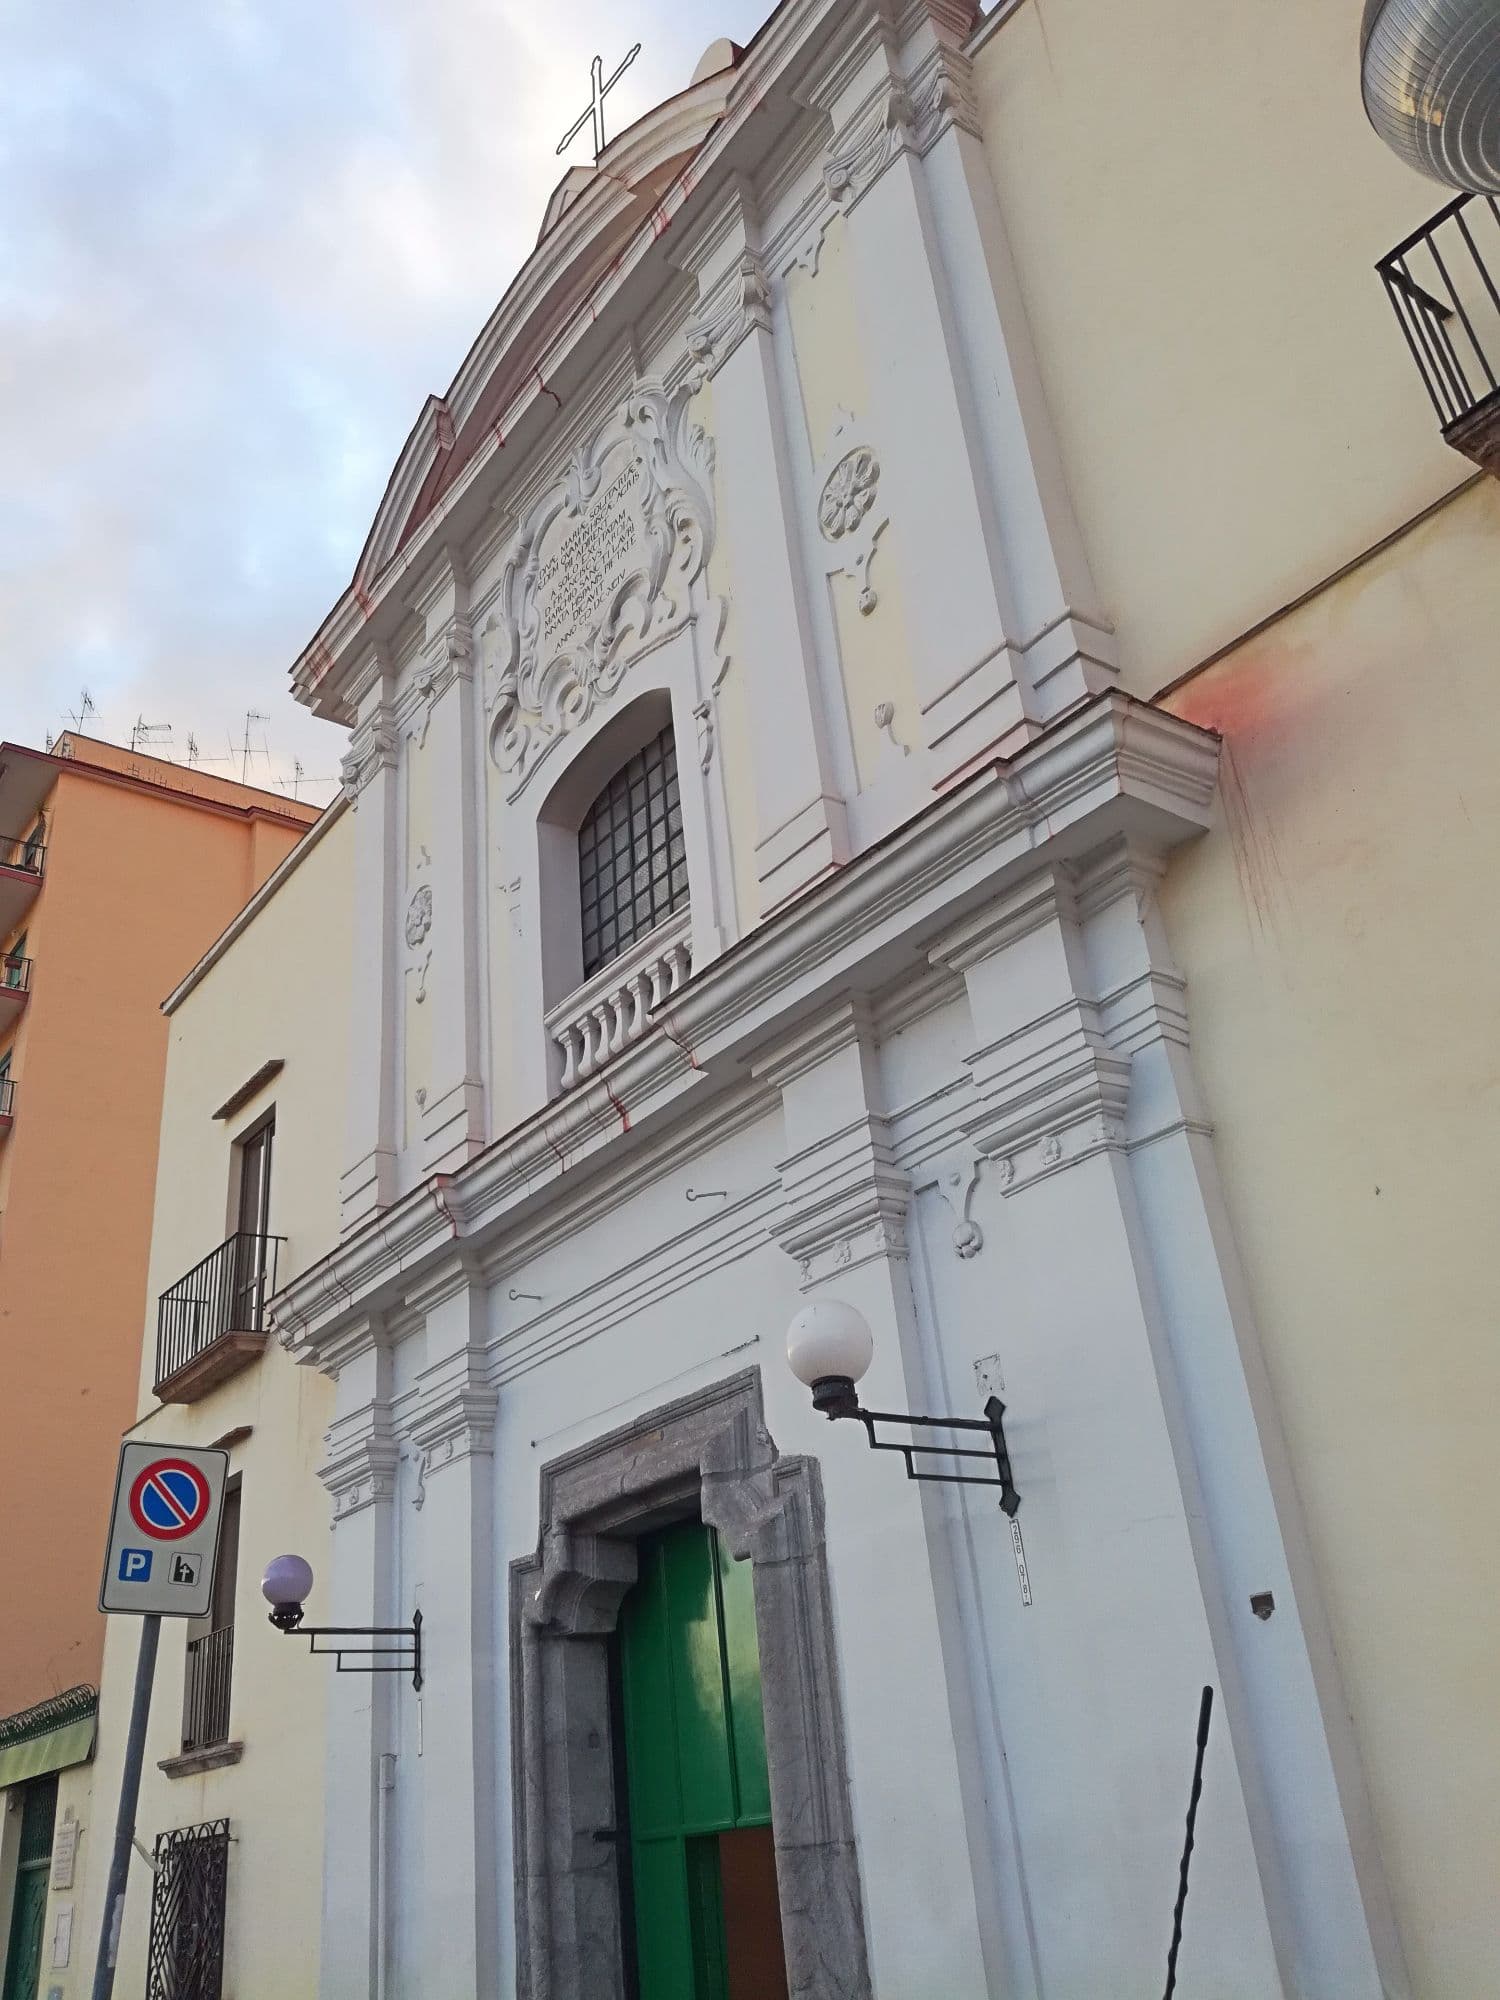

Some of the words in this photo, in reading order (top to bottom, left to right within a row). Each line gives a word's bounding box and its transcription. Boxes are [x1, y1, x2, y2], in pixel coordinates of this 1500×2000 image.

[558, 561, 578, 592] SOLO
[581, 507, 625, 565] EXCITATAM
[544, 584, 576, 629] MARCHIO
[579, 548, 609, 590] SANCTI
[553, 545, 601, 608] FRANCISCVS
[573, 579, 604, 621] DICAVIT
[555, 624, 577, 653] ANNO
[126, 1554, 146, 1576] P
